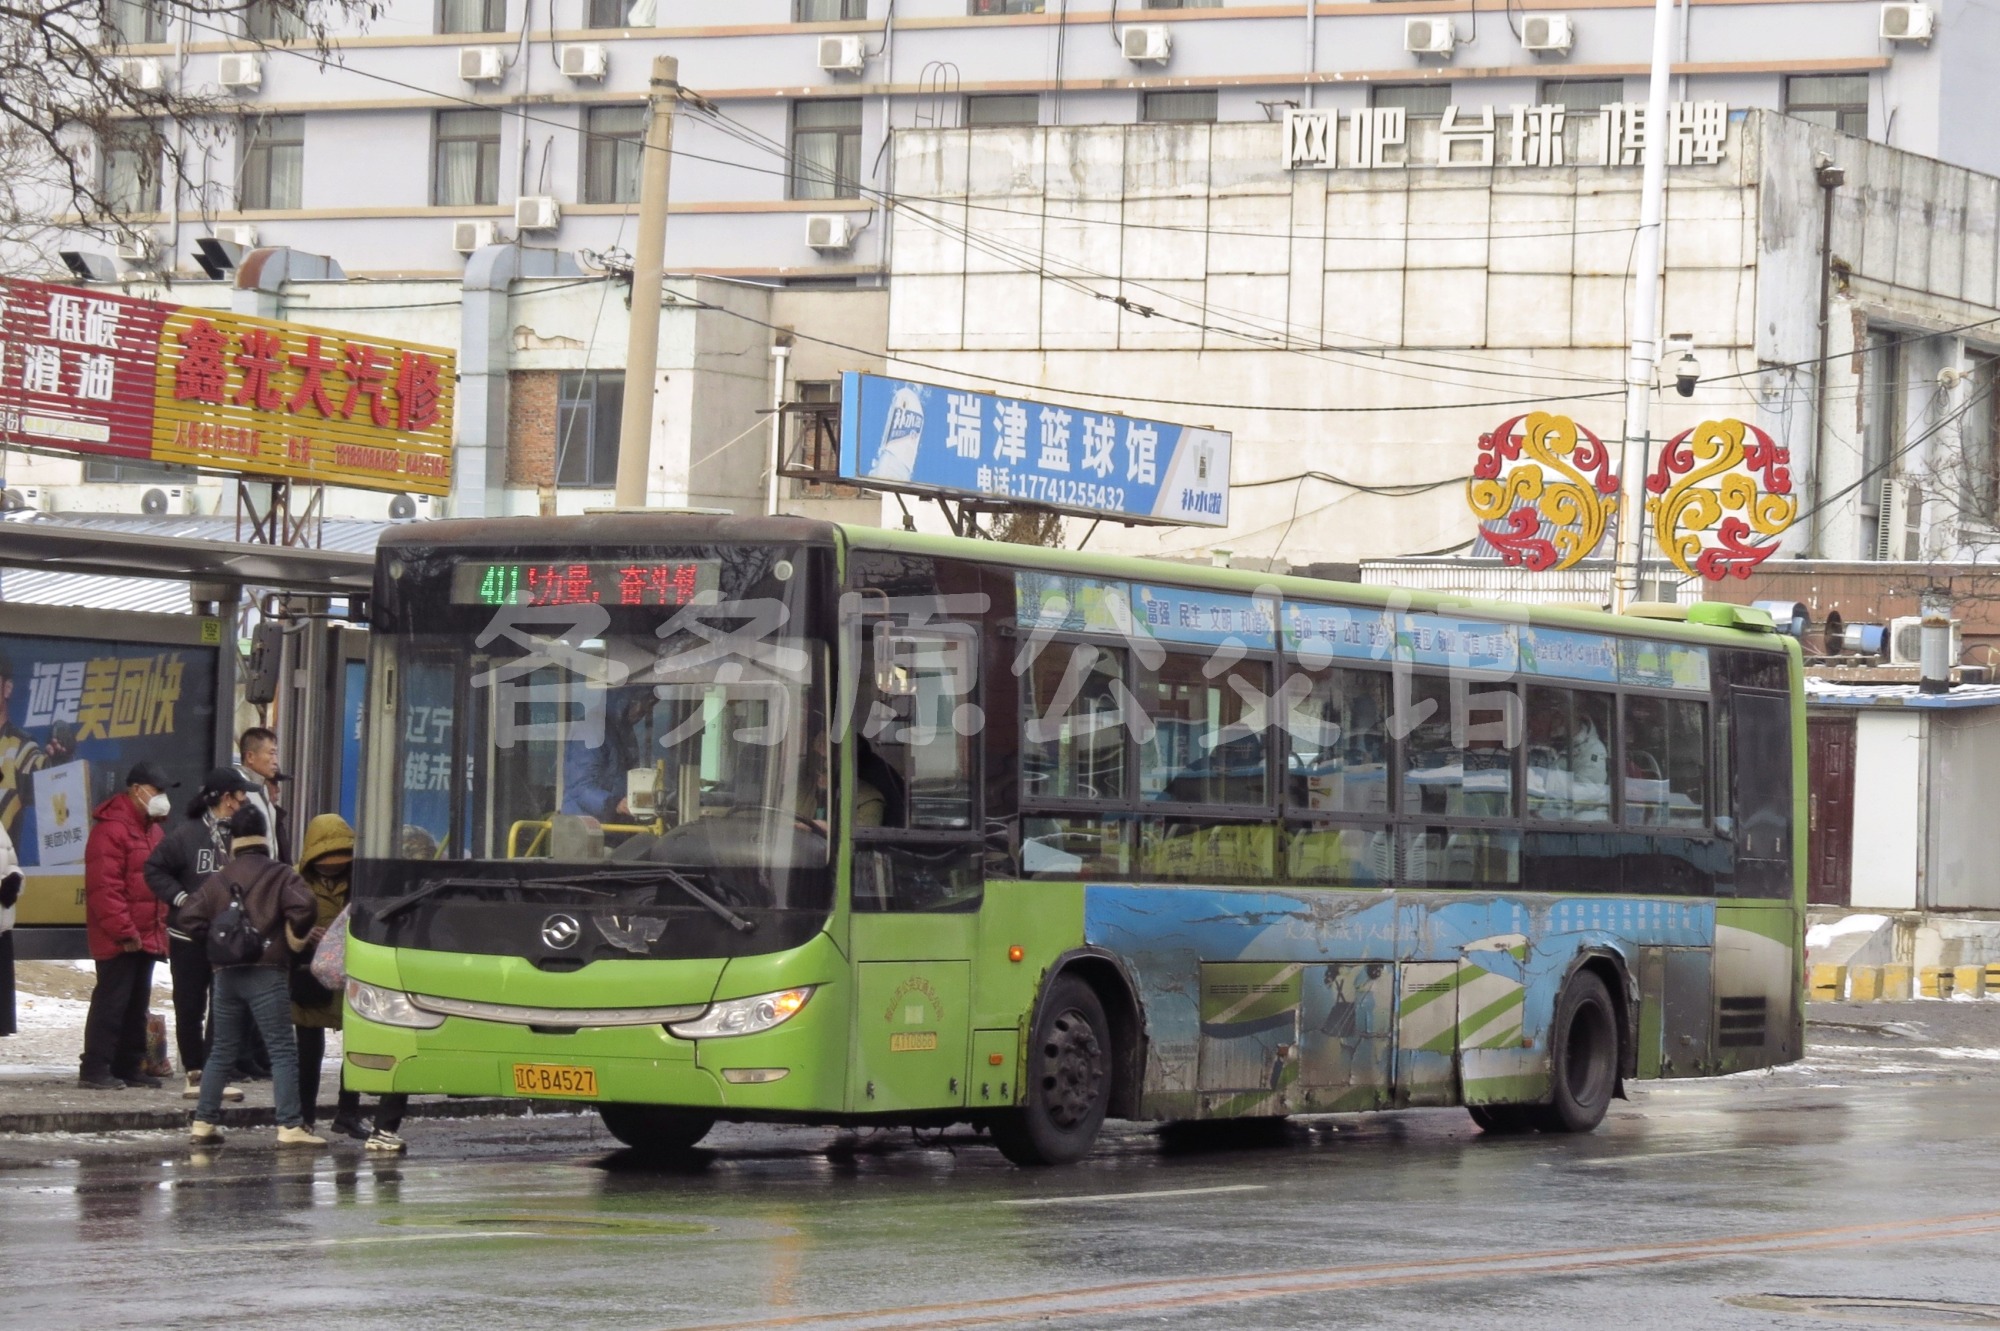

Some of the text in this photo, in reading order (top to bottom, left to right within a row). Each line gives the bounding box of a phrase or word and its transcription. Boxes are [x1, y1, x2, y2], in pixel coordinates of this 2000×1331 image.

[1283, 100, 1728, 170] 网吧 台球 棋牌
[173, 318, 443, 432] 鑫光大汽修
[945, 393, 1159, 486] 瑞津篮球馆
[1181, 488, 1222, 515] 补水啦
[1147, 600, 1171, 626] 富强
[1179, 603, 1202, 628] 民主
[1210, 606, 1233, 632] 文明
[1240, 610, 1263, 635] 和谐
[1294, 616, 1313, 640] 自由
[1318, 617, 1337, 642] 平等
[1343, 620, 1362, 645] 公正
[405, 704, 454, 744] 辽宁
[44, 827, 82, 849] 美团外卖
